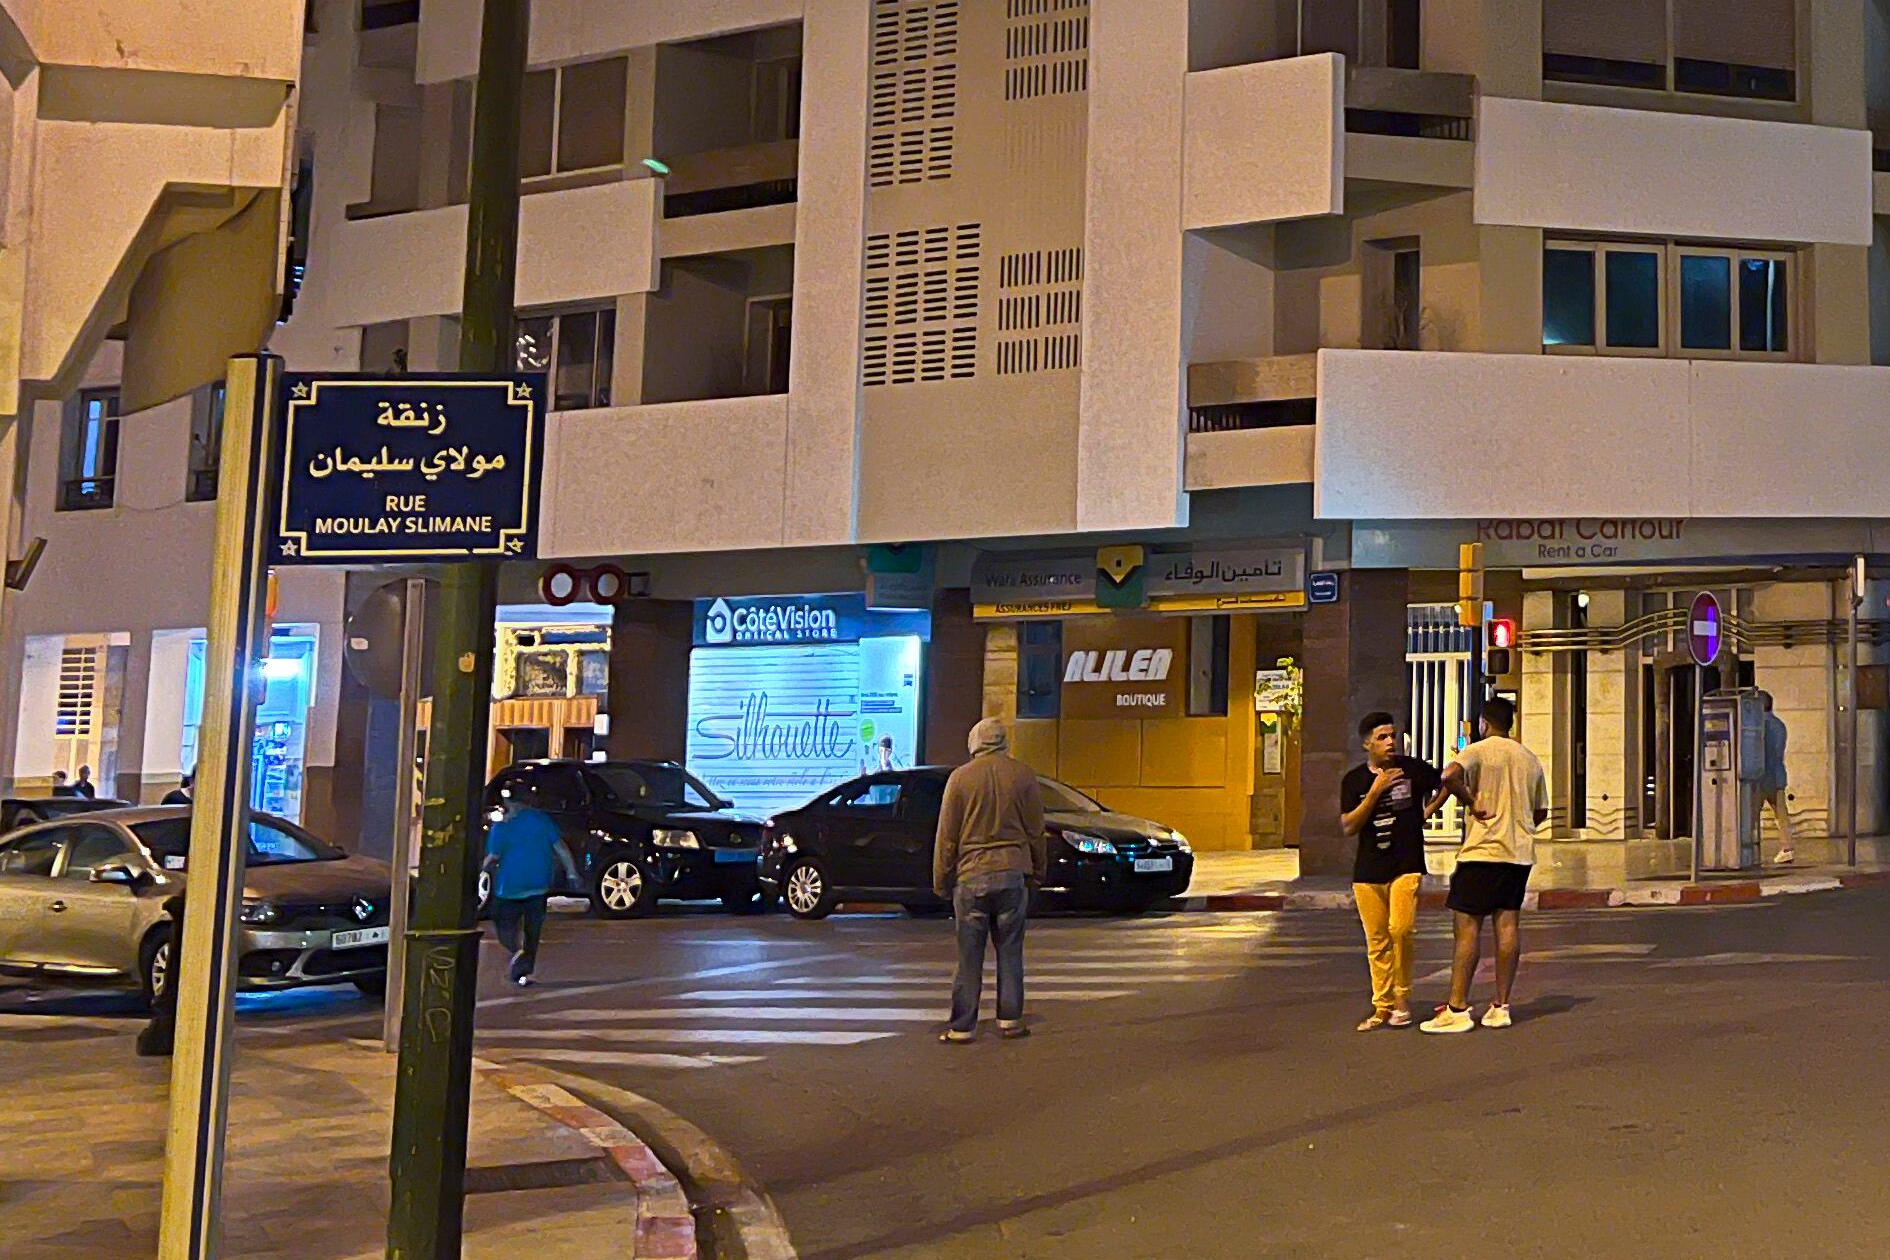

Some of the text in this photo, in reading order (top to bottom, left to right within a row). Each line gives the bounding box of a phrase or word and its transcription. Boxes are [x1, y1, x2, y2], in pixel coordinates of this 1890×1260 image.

[376, 401, 447, 435] زنقة
[309, 445, 506, 481] مولاي سليمان
[385, 495, 427, 512] RUE
[315, 516, 492, 534] MOULAY SLIMANE
[1538, 544, 1618, 558] Rent a Car
[1020, 572, 1082, 587] Assurance
[733, 605, 836, 632] CôtéVision
[735, 628, 838, 640] OPTICAL STORE
[1116, 694, 1166, 707] BOUTIQUE
[692, 691, 857, 761] Silhouette
